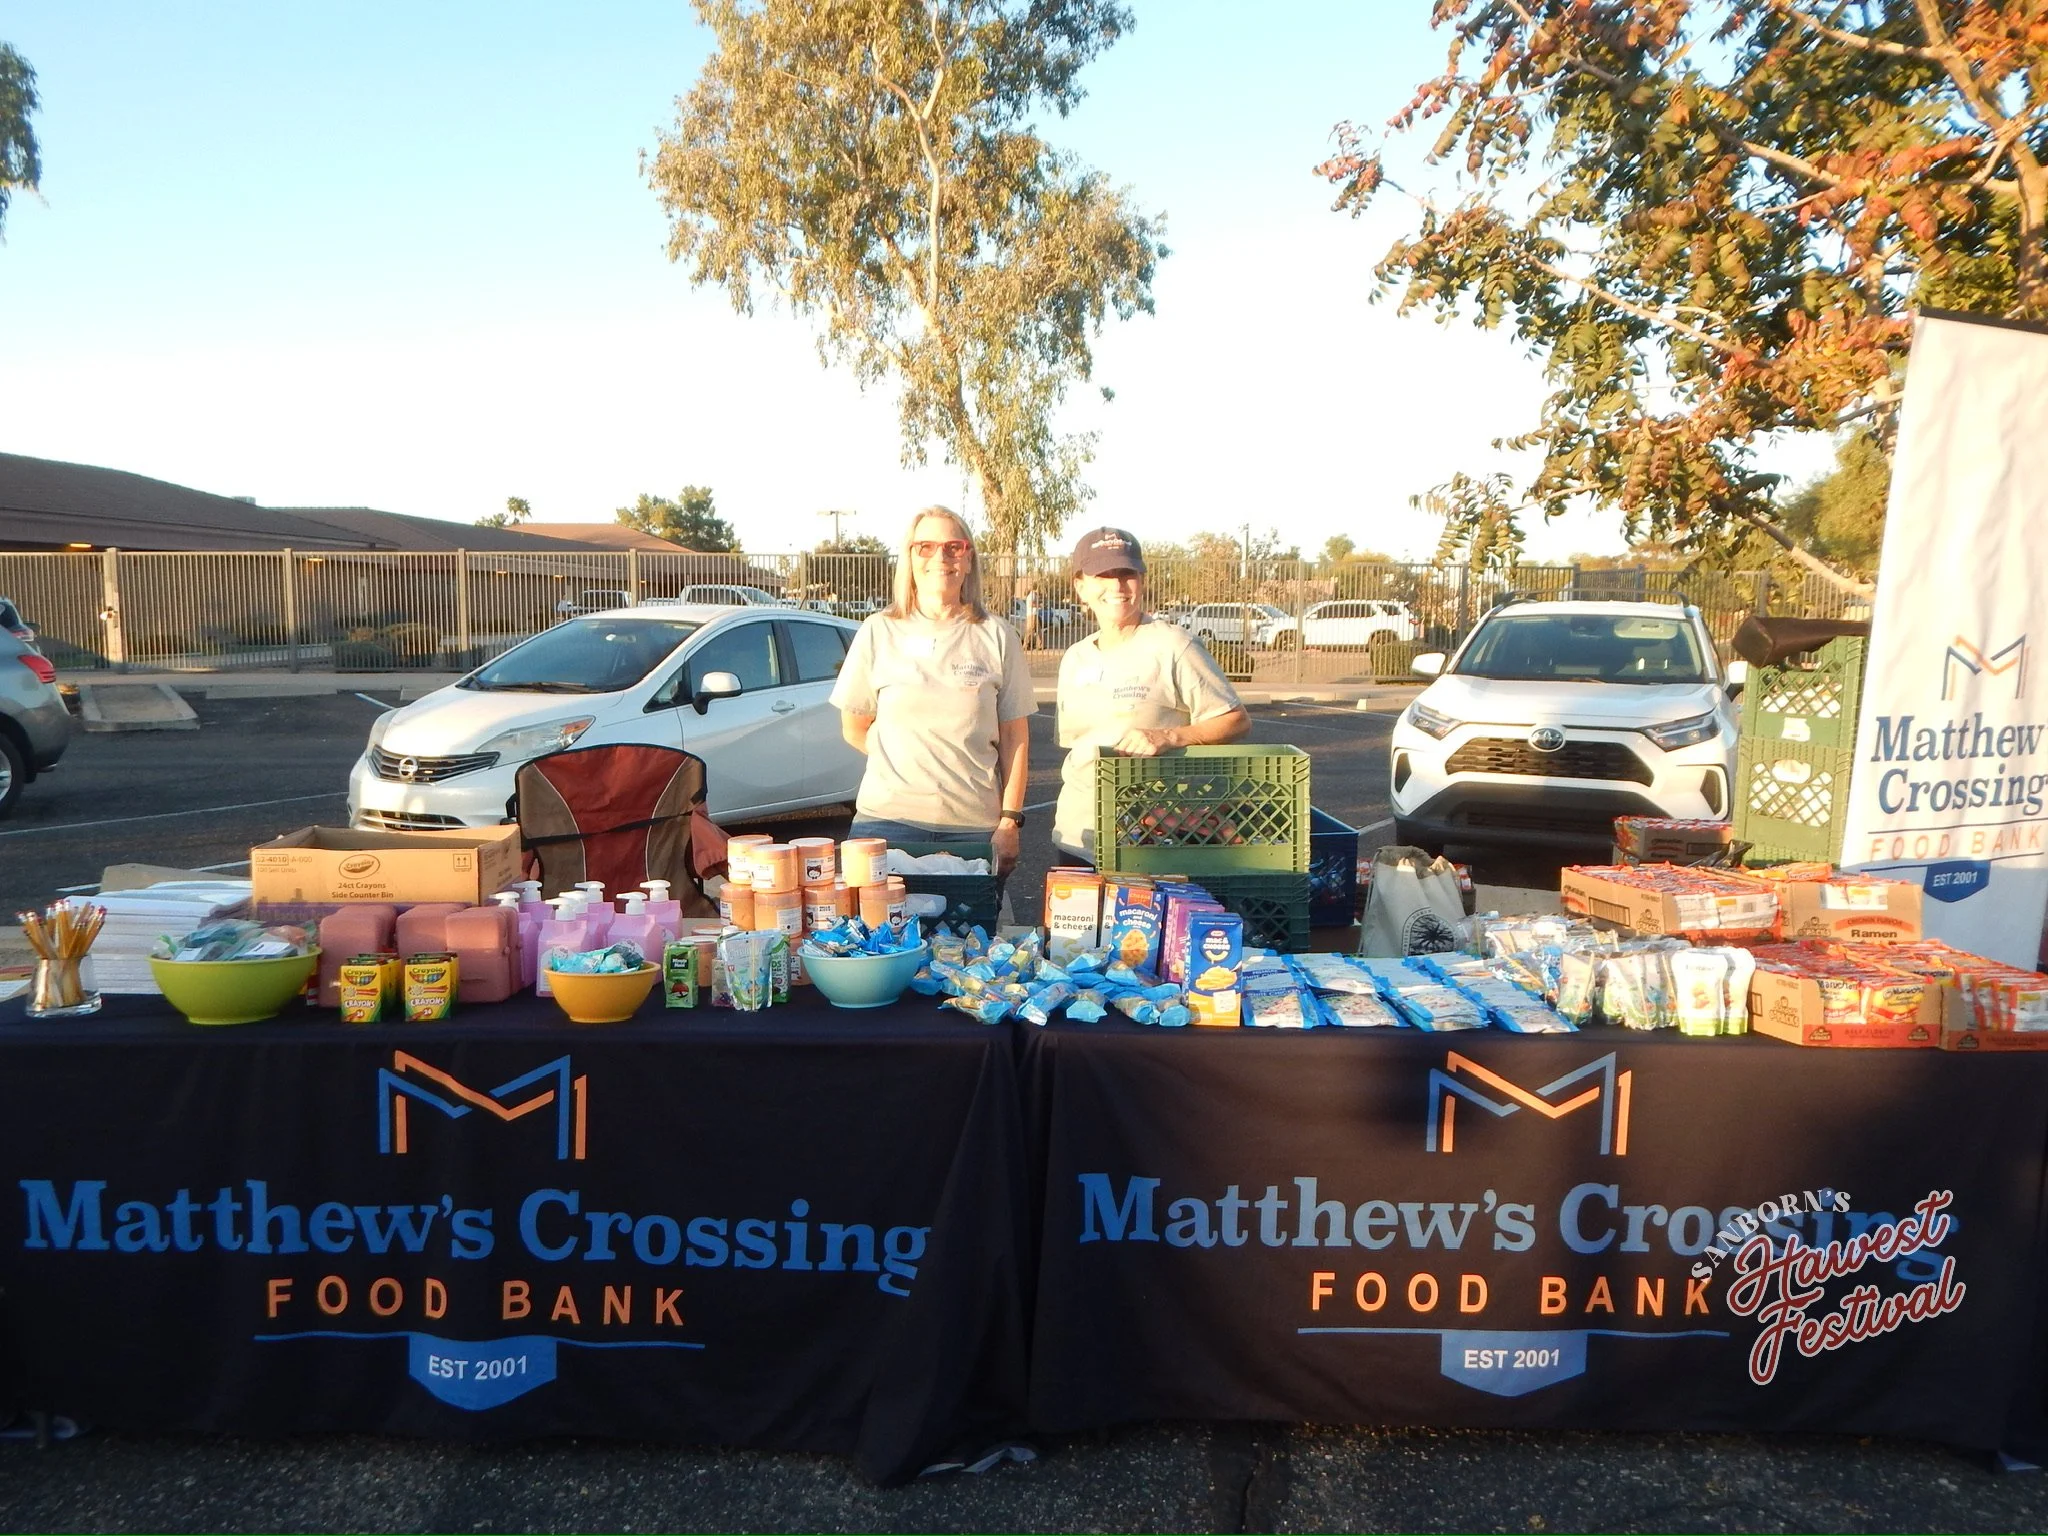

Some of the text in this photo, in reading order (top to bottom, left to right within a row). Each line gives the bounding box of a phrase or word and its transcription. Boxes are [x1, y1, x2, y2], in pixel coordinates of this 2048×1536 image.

[1878, 763, 2048, 816] Crossing
[1869, 825, 2043, 861] FOOD BANK
[356, 881, 386, 890] Crayons
[1932, 871, 1978, 887] EST 2001
[349, 891, 380, 899] Counter
[380, 890, 394, 898] Bin
[1053, 913, 1094, 923] macaroni
[1119, 908, 1158, 921] macaroni
[1062, 922, 1093, 931] cheese
[1122, 918, 1152, 930] cheese
[1851, 929, 1898, 938] Ramen
[345, 1000, 376, 1008] CRAYONS
[410, 998, 445, 1006] CRAYONS
[1077, 1172, 1538, 1254] Matthew's
[20, 1178, 933, 1298] Matthew's Crossing
[267, 1275, 684, 1326] FOOD BANK
[1311, 1271, 1711, 1318] FOOD BANK
[1462, 1347, 1561, 1371] EST 2001
[428, 1354, 528, 1381] EST 2001
